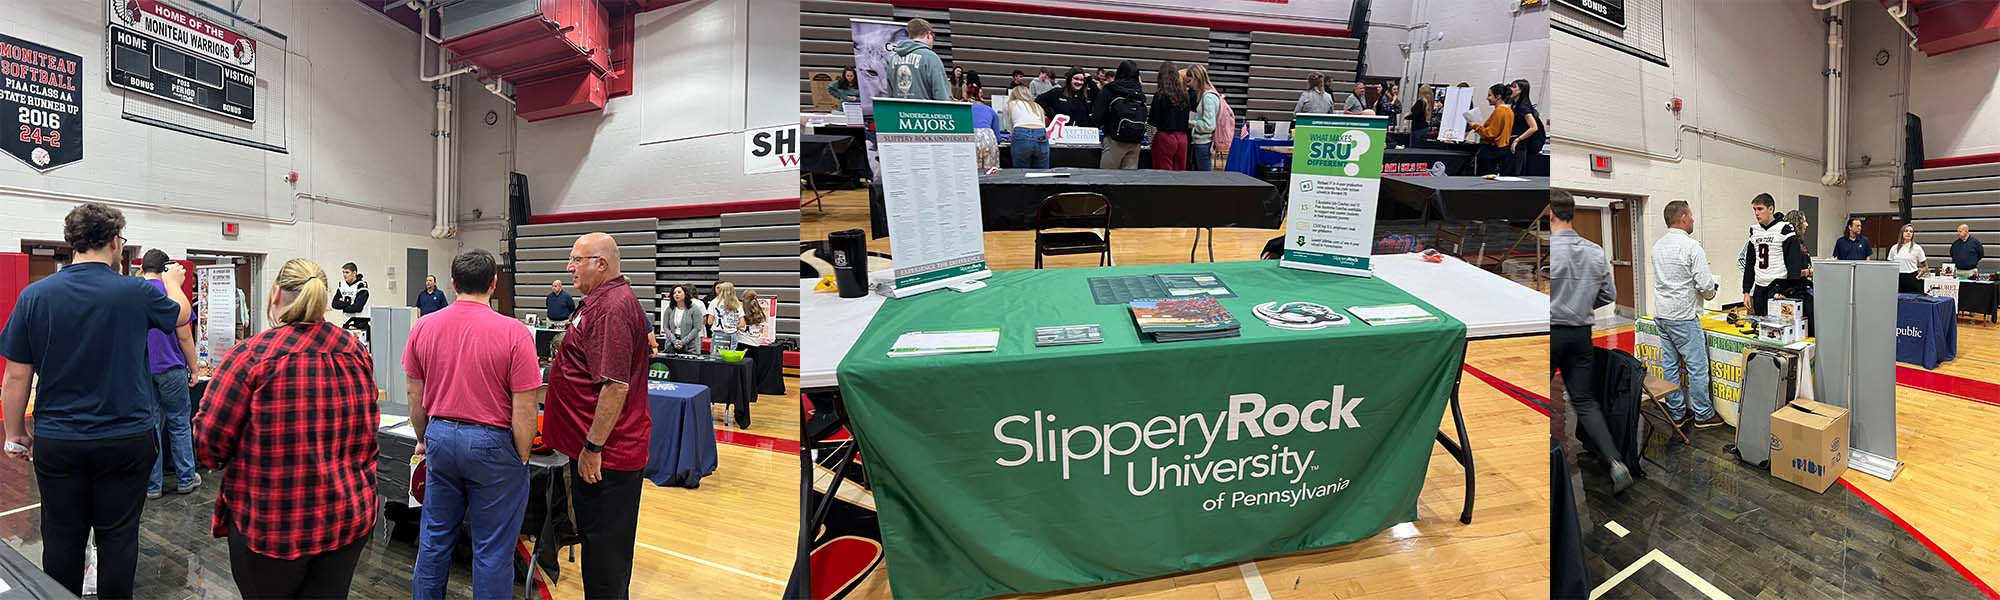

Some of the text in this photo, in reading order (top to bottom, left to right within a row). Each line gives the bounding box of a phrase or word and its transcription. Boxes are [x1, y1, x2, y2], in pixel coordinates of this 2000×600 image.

[154, 5, 224, 39] HOME OF THE
[117, 32, 147, 50] HOME
[145, 17, 230, 59] MONITEAU WARRIORS
[0, 42, 77, 75] MONITEAU
[1, 60, 76, 91] SOFTBALL
[130, 77, 154, 91] BONUS
[224, 68, 254, 86] VISITOR
[5, 77, 73, 103] PIAA CLASS AA
[171, 83, 196, 97] PERIOD
[0, 89, 79, 115] STATE RUNNER UP
[222, 104, 241, 115] BONUS
[18, 106, 60, 129] 2016
[899, 112, 953, 120] UNDERGRADUATE
[899, 119, 955, 132] MAJORS
[19, 124, 61, 148] 24-2
[1310, 133, 1352, 142] WHAT MAKES
[1309, 141, 1352, 160] SRU
[1758, 243, 1770, 269] 9
[1895, 325, 1923, 338] public
[1127, 444, 1315, 497] University
[1202, 477, 1351, 512] of Pennsylvania
